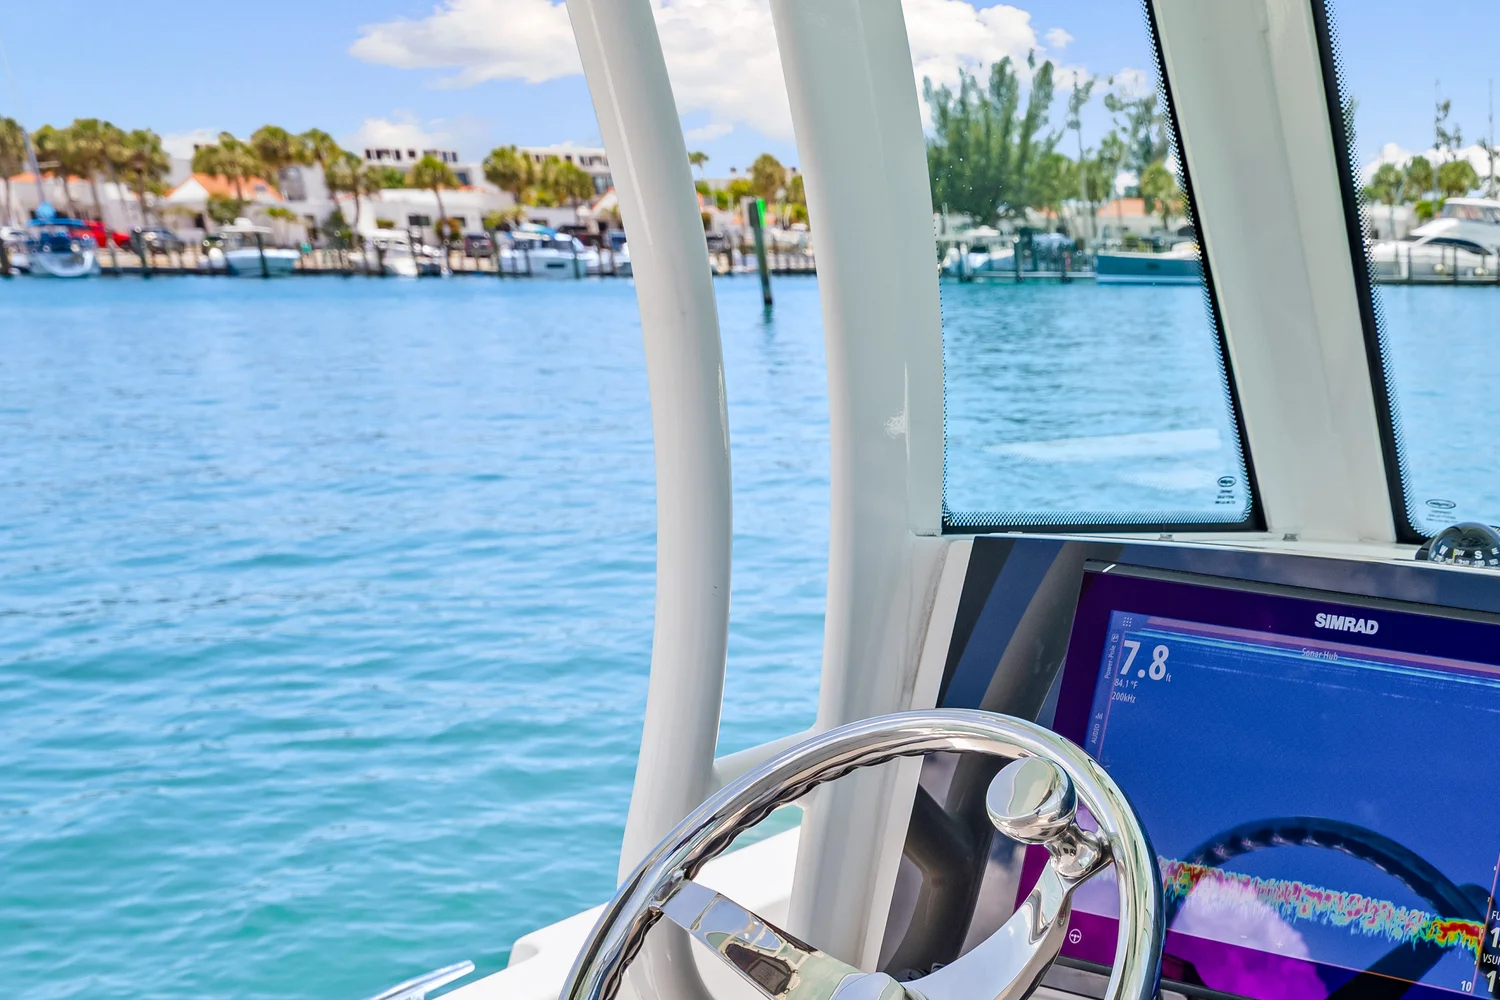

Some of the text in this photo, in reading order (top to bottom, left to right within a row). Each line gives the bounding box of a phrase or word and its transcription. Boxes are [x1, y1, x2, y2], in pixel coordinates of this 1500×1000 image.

[1474, 550, 1482, 559] S
[1314, 612, 1379, 635] SIMRAD
[1302, 648, 1338, 660] Sonar Hub
[1120, 640, 1169, 681] 7.8
[1114, 678, 1129, 688] 84.1
[1112, 691, 1136, 703] 200kHz
[1091, 723, 1100, 744] AUDIO
[1461, 980, 1472, 992] 10
